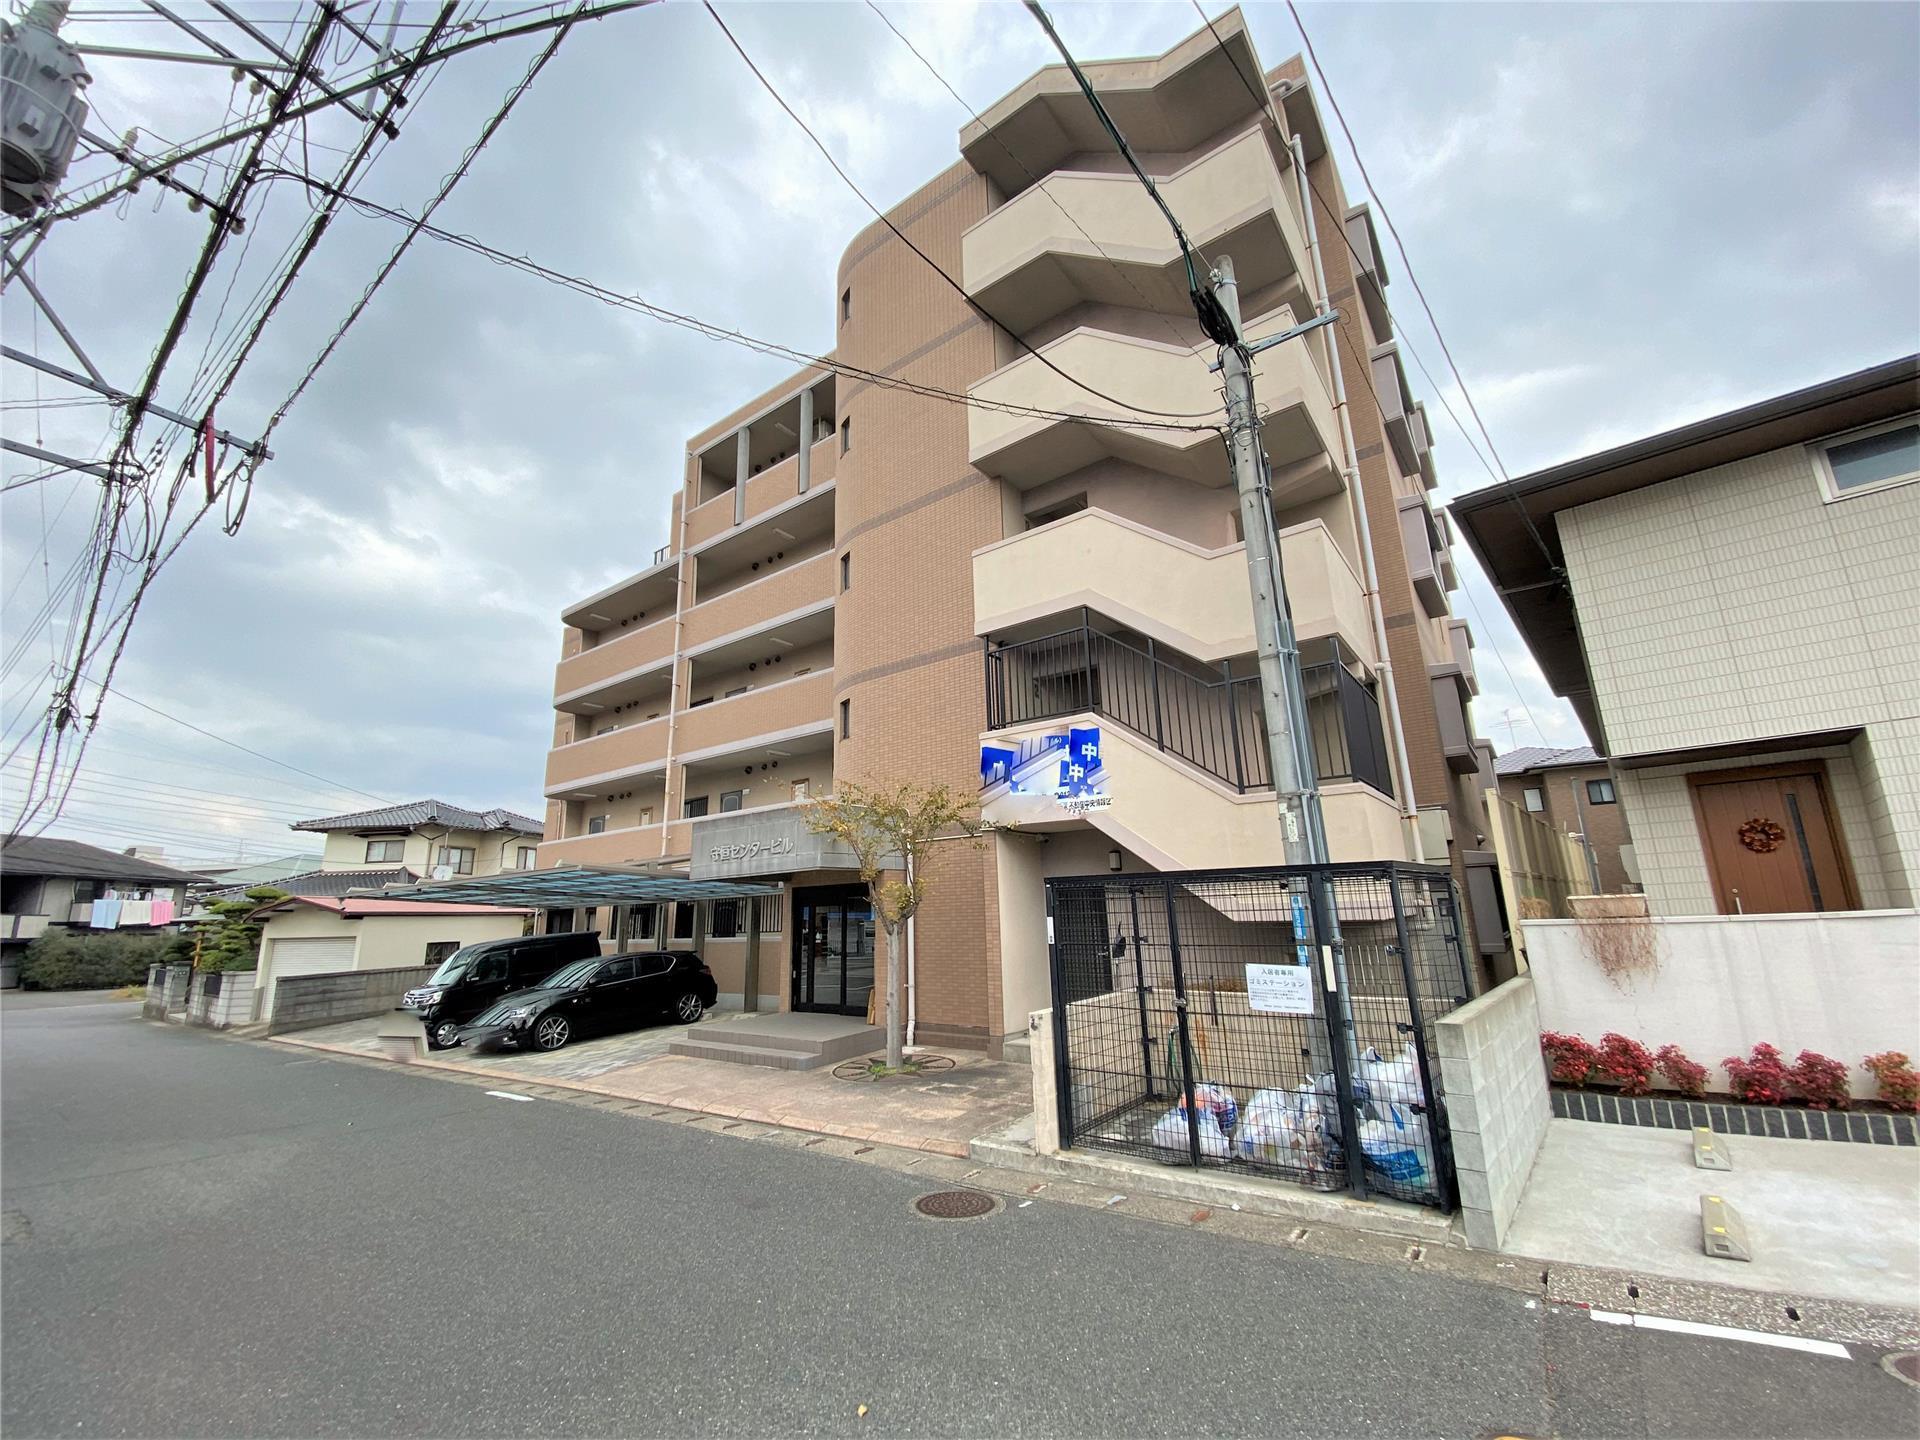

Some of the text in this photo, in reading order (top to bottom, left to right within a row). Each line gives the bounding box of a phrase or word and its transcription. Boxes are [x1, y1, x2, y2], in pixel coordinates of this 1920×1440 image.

[1081, 742, 1097, 761] 中
[1068, 763, 1084, 782] 中
[710, 837, 794, 862] 守恒センタービル
[1261, 968, 1294, 977] 入居者専用
[1249, 978, 1305, 988] ゴミステーション
